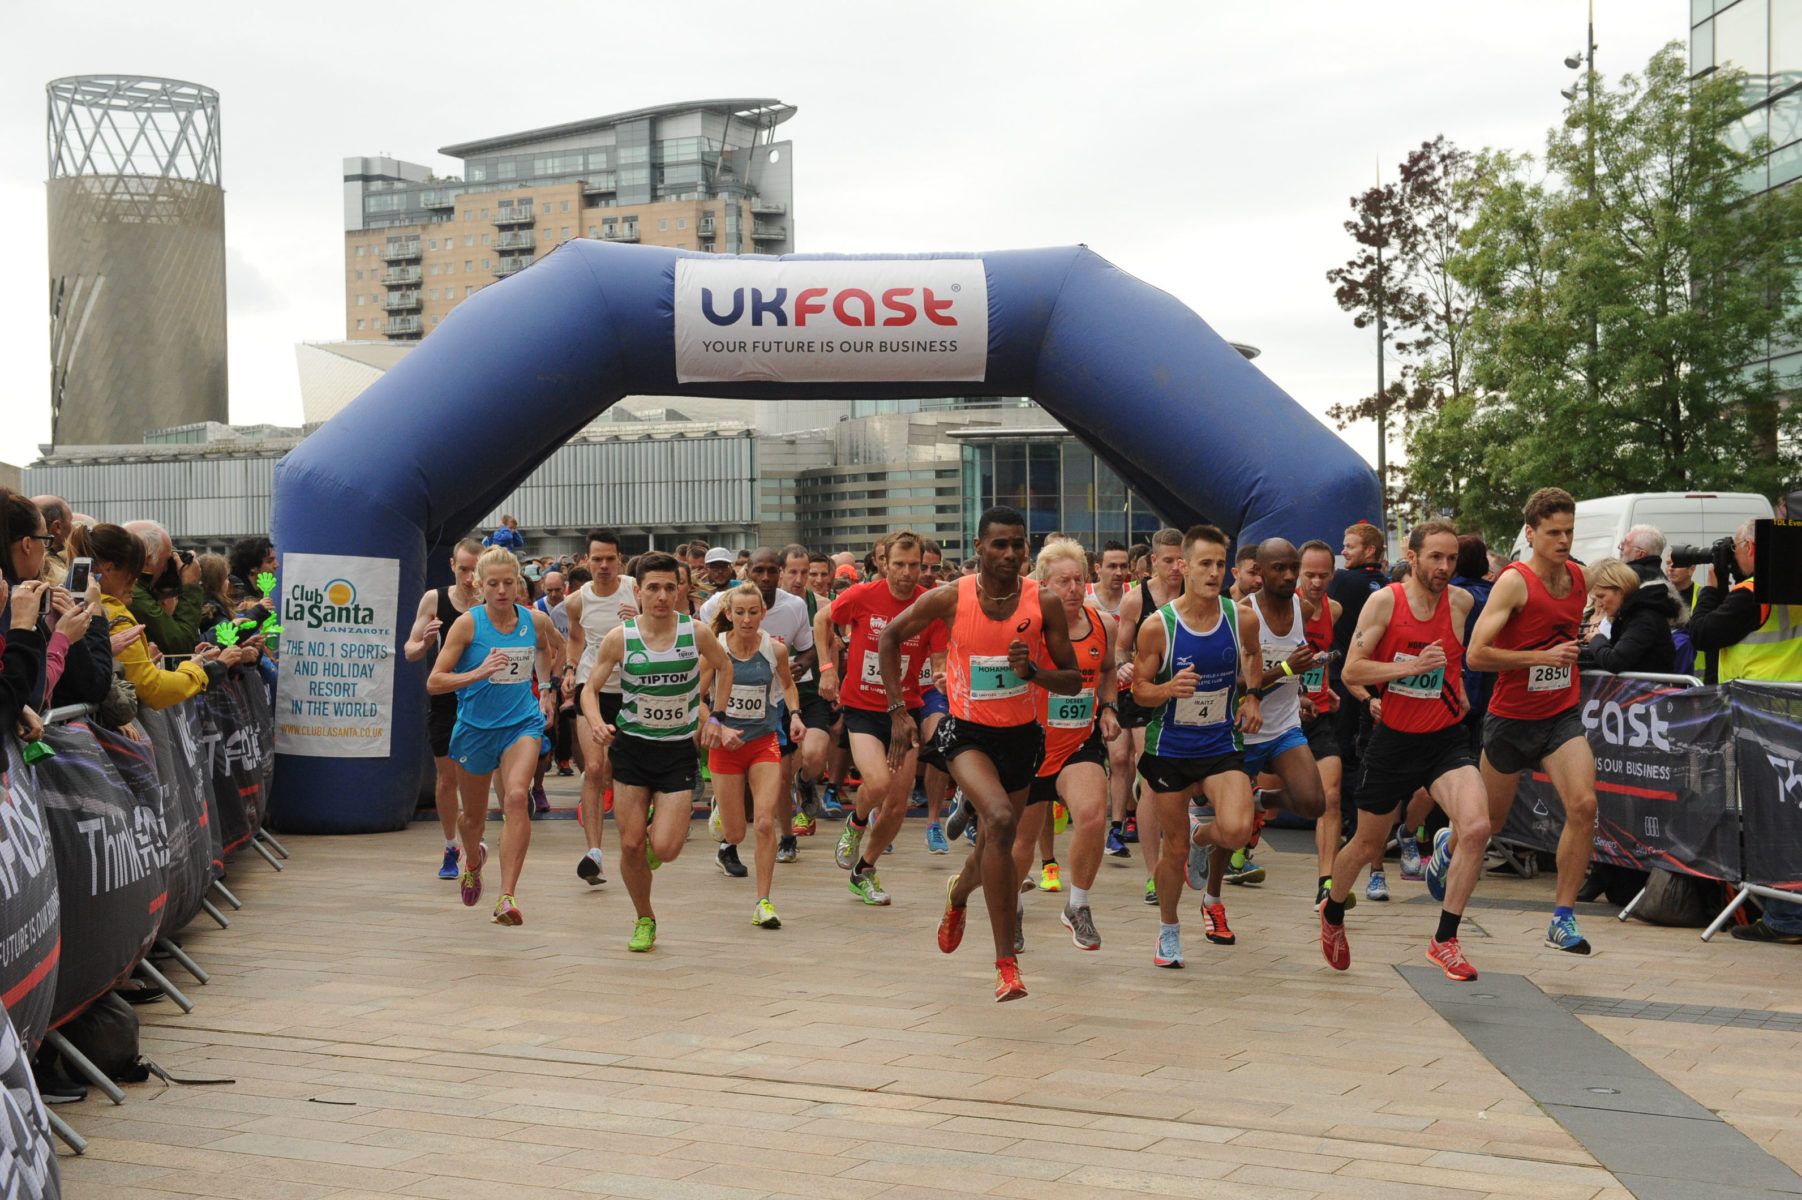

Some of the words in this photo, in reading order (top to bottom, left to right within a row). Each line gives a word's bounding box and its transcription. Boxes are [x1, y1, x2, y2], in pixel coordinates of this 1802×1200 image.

[702, 340, 747, 353] YOUR
[752, 340, 815, 353] FUTURE
[820, 341, 834, 353] IS
[839, 341, 874, 353] OUR
[879, 340, 958, 352] BUSINESS
[292, 584, 324, 605] Club
[323, 626, 390, 636] LANZAROTE
[286, 640, 304, 656] THE
[340, 643, 388, 660] SPORTS
[294, 661, 318, 676] AND
[323, 662, 375, 679] HOLIDAY
[510, 662, 519, 675] 2
[1535, 667, 1569, 682] 2850
[639, 673, 689, 685] TIPTON
[995, 674, 1005, 688] 1
[1301, 672, 1320, 685] 77
[309, 681, 358, 698] RESORT
[291, 700, 302, 715] IN
[306, 700, 329, 717] THE
[333, 702, 377, 718] WORLD
[727, 697, 762, 711] 3300
[643, 708, 684, 721] 3036
[1059, 705, 1087, 719] 697
[1198, 706, 1208, 719] 4
[1603, 758, 1623, 774] OUR
[1626, 761, 1671, 781] BUSINESS
[28, 917, 37, 947] IS
